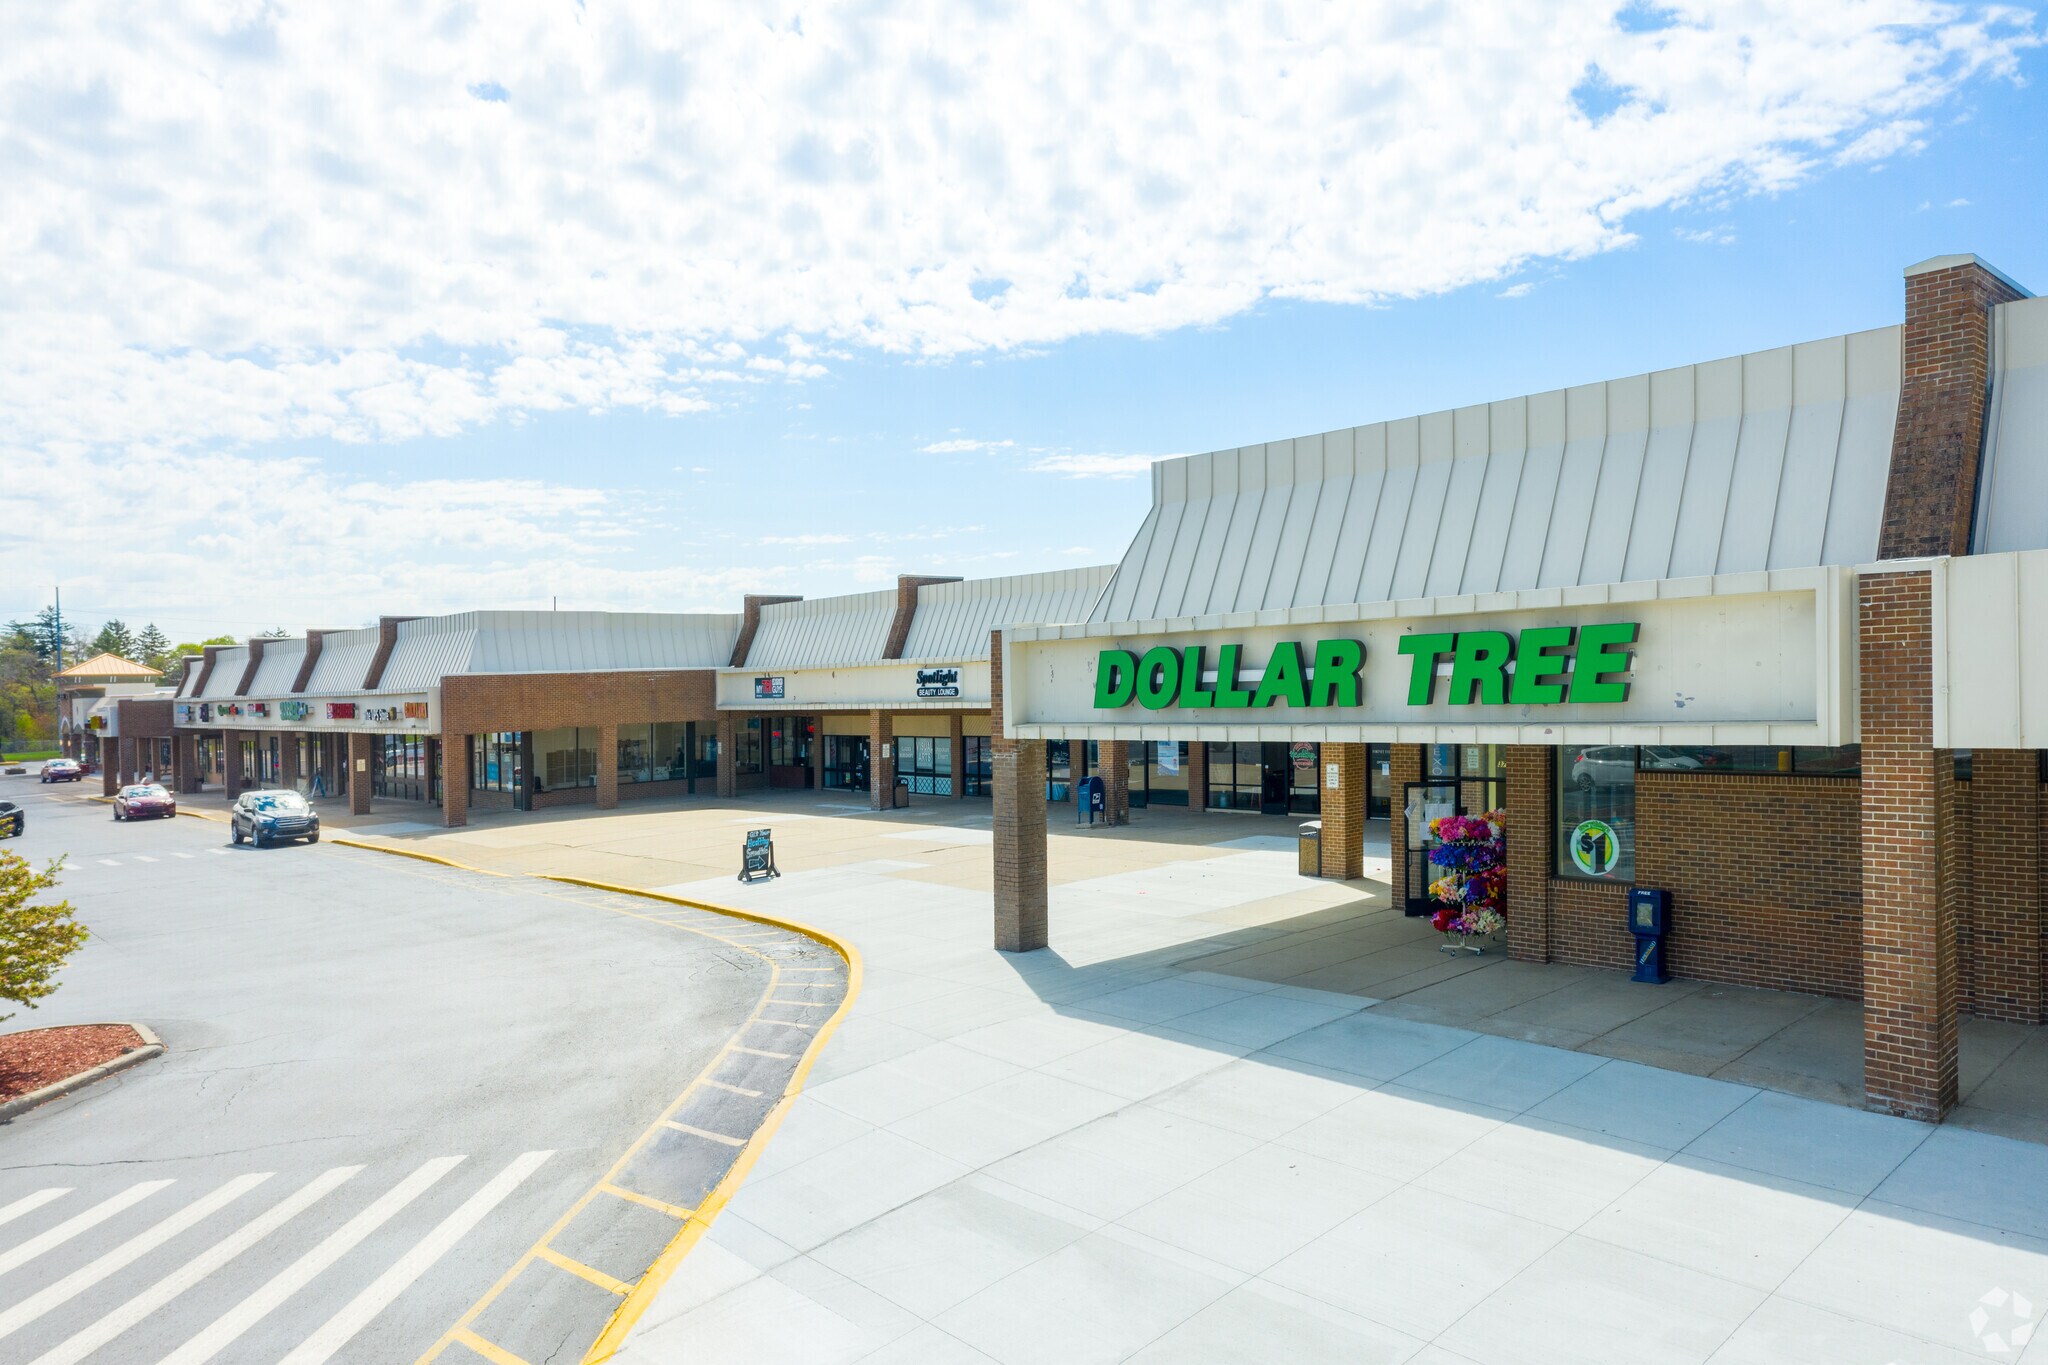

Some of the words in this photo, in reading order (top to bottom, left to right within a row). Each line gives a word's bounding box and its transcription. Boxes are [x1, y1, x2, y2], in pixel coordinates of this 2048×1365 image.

[916, 669, 958, 686] Spotlight
[1094, 639, 1366, 710] DOLLAR
[1397, 623, 1640, 706] TREE
[1580, 832, 1607, 873] $1
